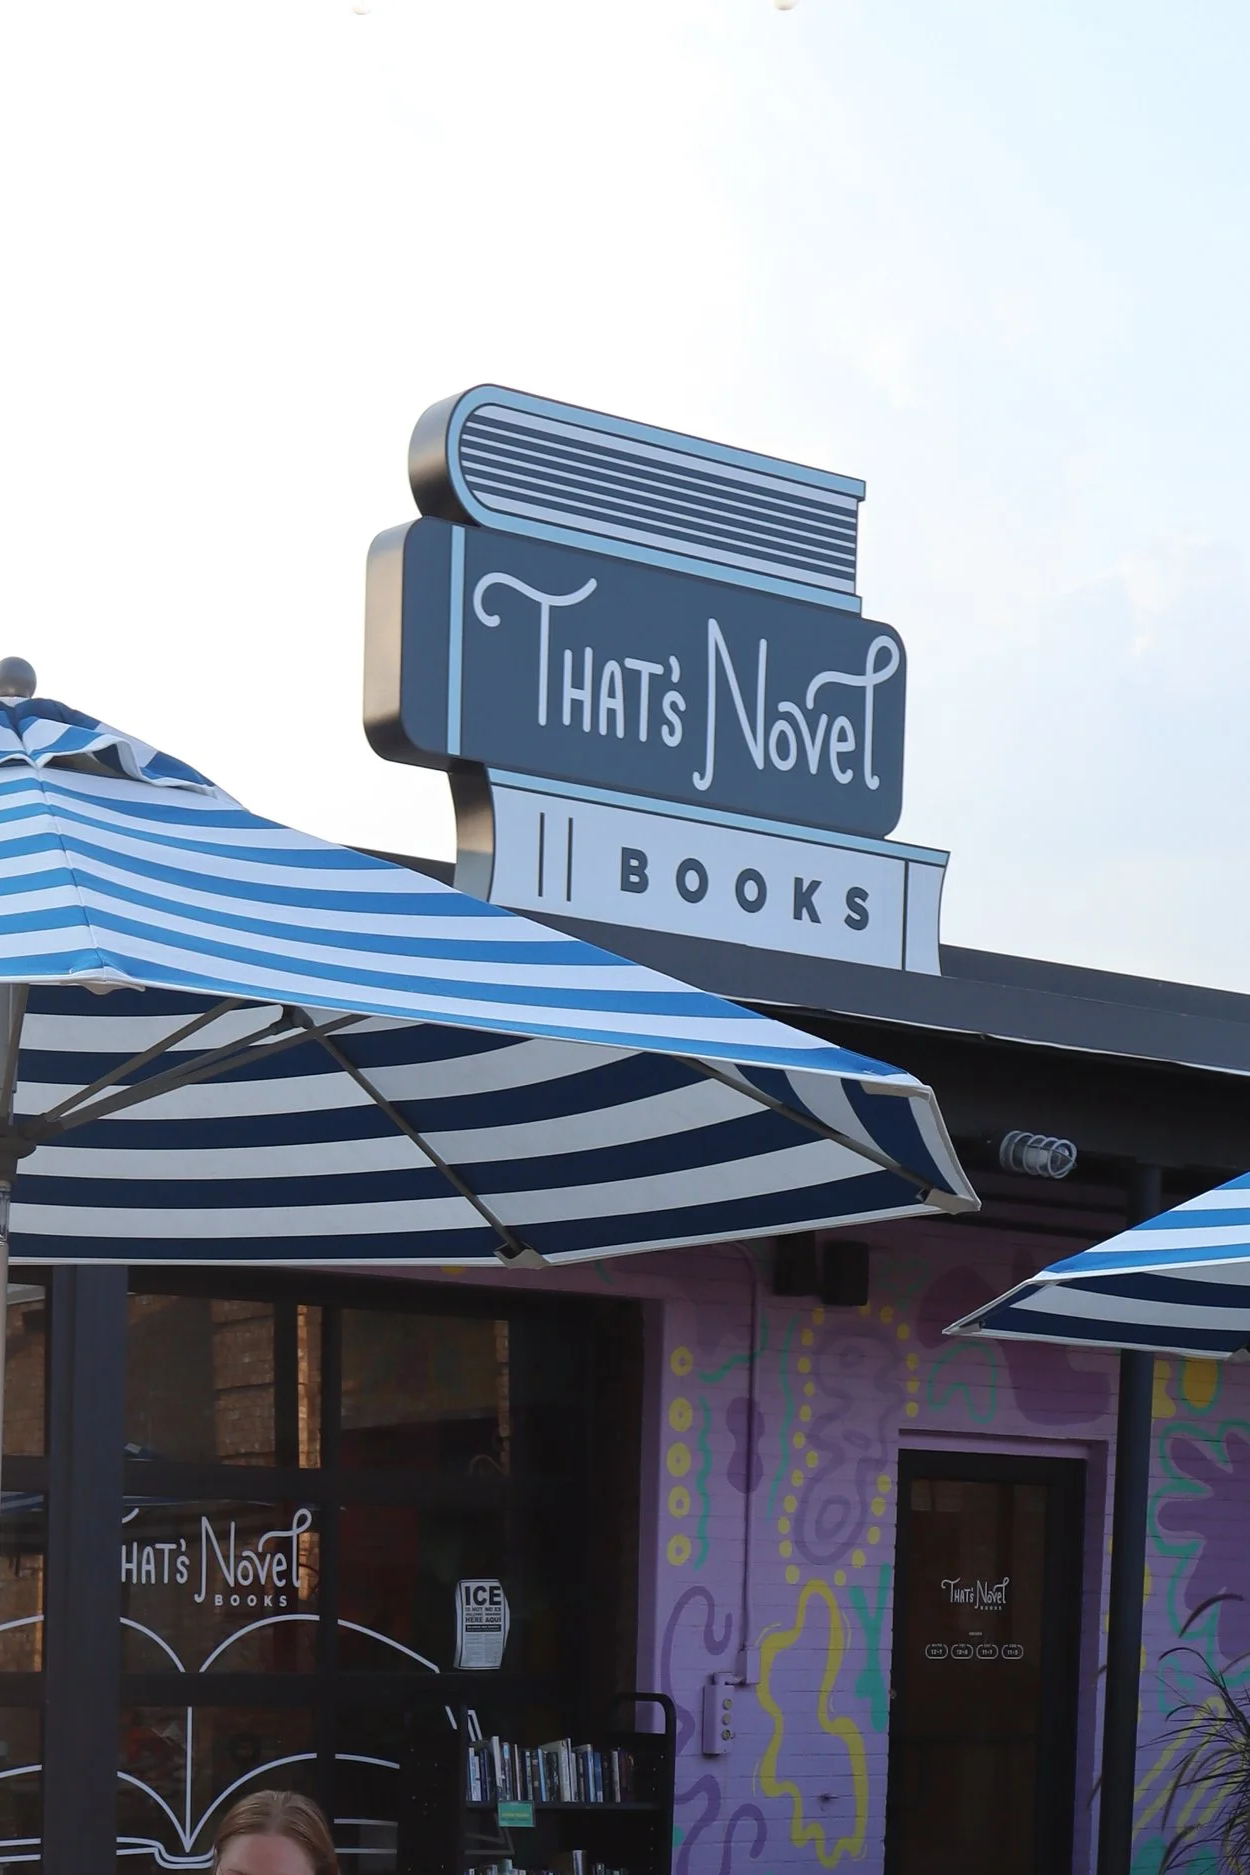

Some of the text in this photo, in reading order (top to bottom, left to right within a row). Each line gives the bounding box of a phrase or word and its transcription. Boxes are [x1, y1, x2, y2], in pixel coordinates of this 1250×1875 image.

[620, 846, 871, 931] BOOKS
[214, 1594, 288, 1607] BOOKS
[465, 1585, 502, 1606] ICE
